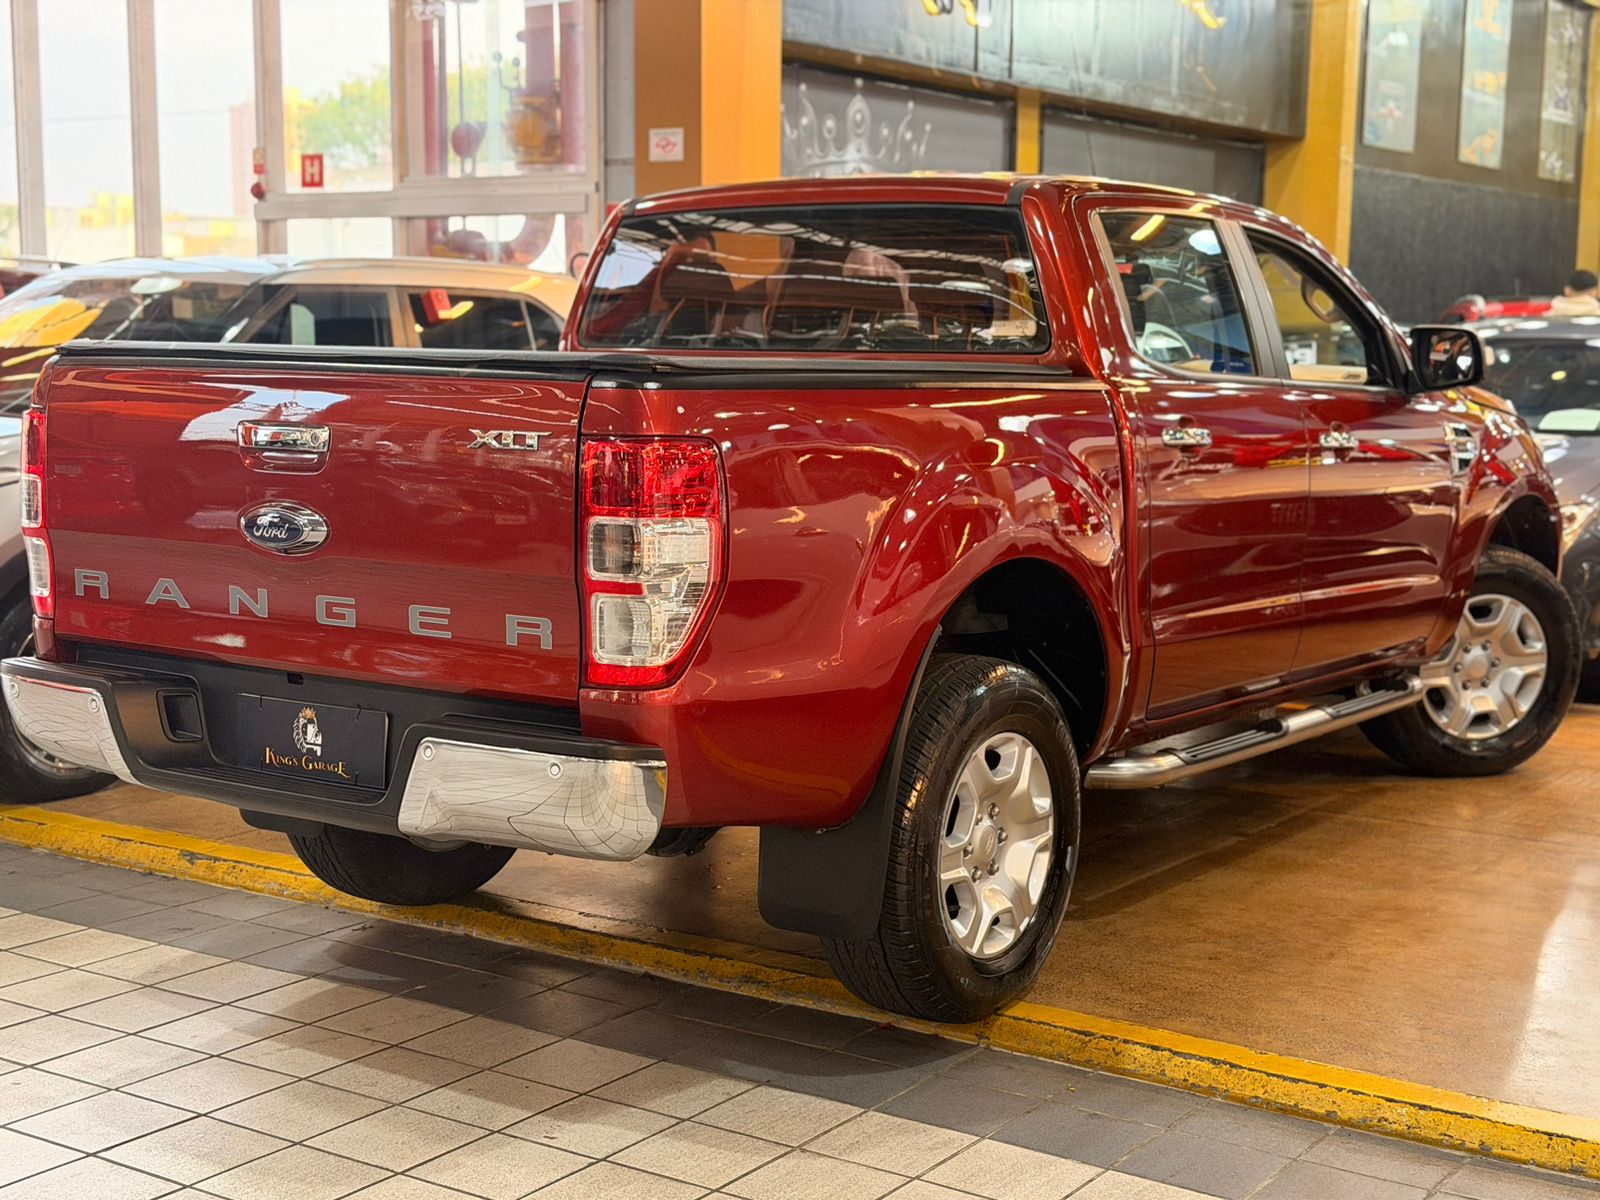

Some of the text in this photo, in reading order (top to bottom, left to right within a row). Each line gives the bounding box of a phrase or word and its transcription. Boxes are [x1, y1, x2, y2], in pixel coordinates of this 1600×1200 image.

[304, 157, 320, 184] H
[467, 428, 553, 451] XLT
[253, 512, 290, 539] Ford
[74, 568, 553, 650] RANGER
[301, 754, 352, 779] GARAGE
